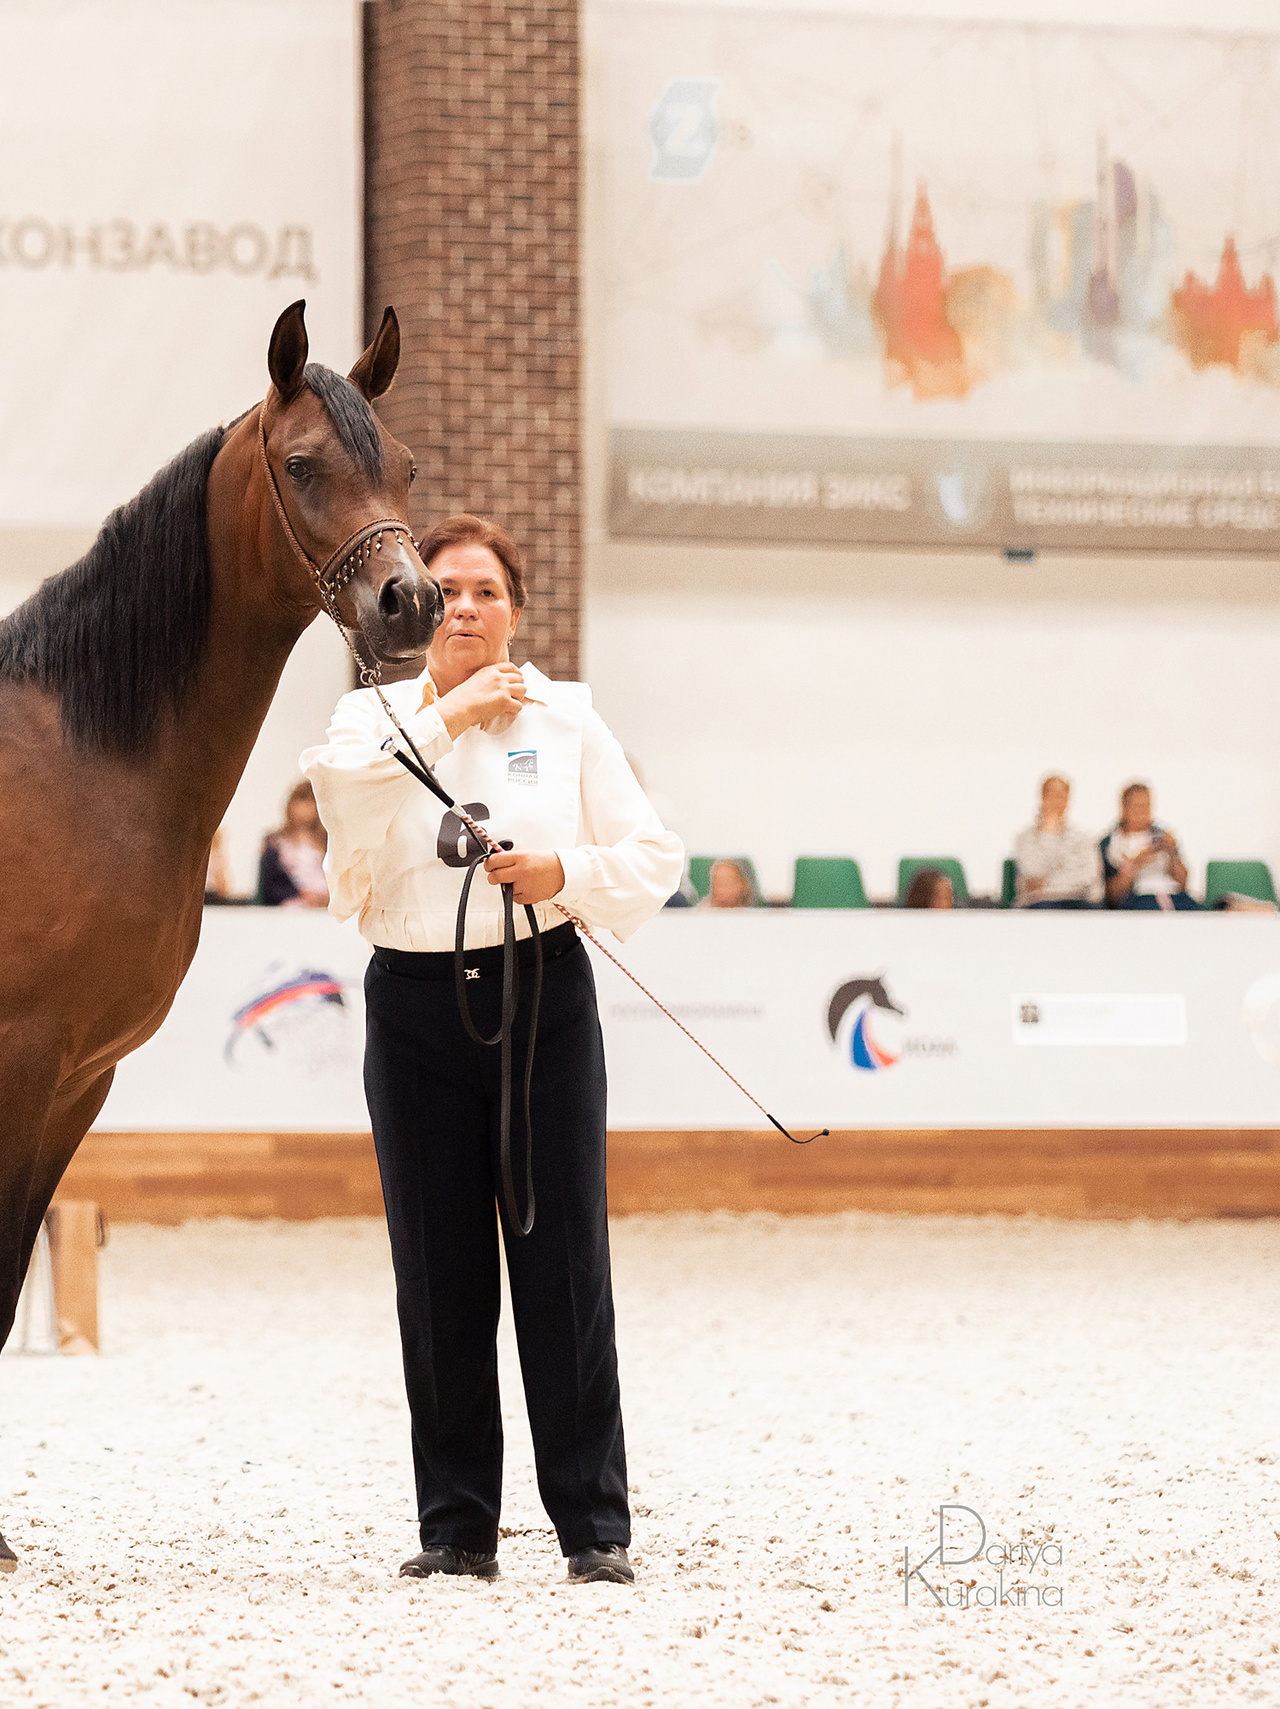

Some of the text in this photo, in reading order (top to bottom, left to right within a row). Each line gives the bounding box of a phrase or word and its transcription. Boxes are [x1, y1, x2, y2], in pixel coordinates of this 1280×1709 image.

[628, 468, 911, 510] КОМПАНИЯ ЗИКС
[508, 777, 538, 785] РОССИЯ
